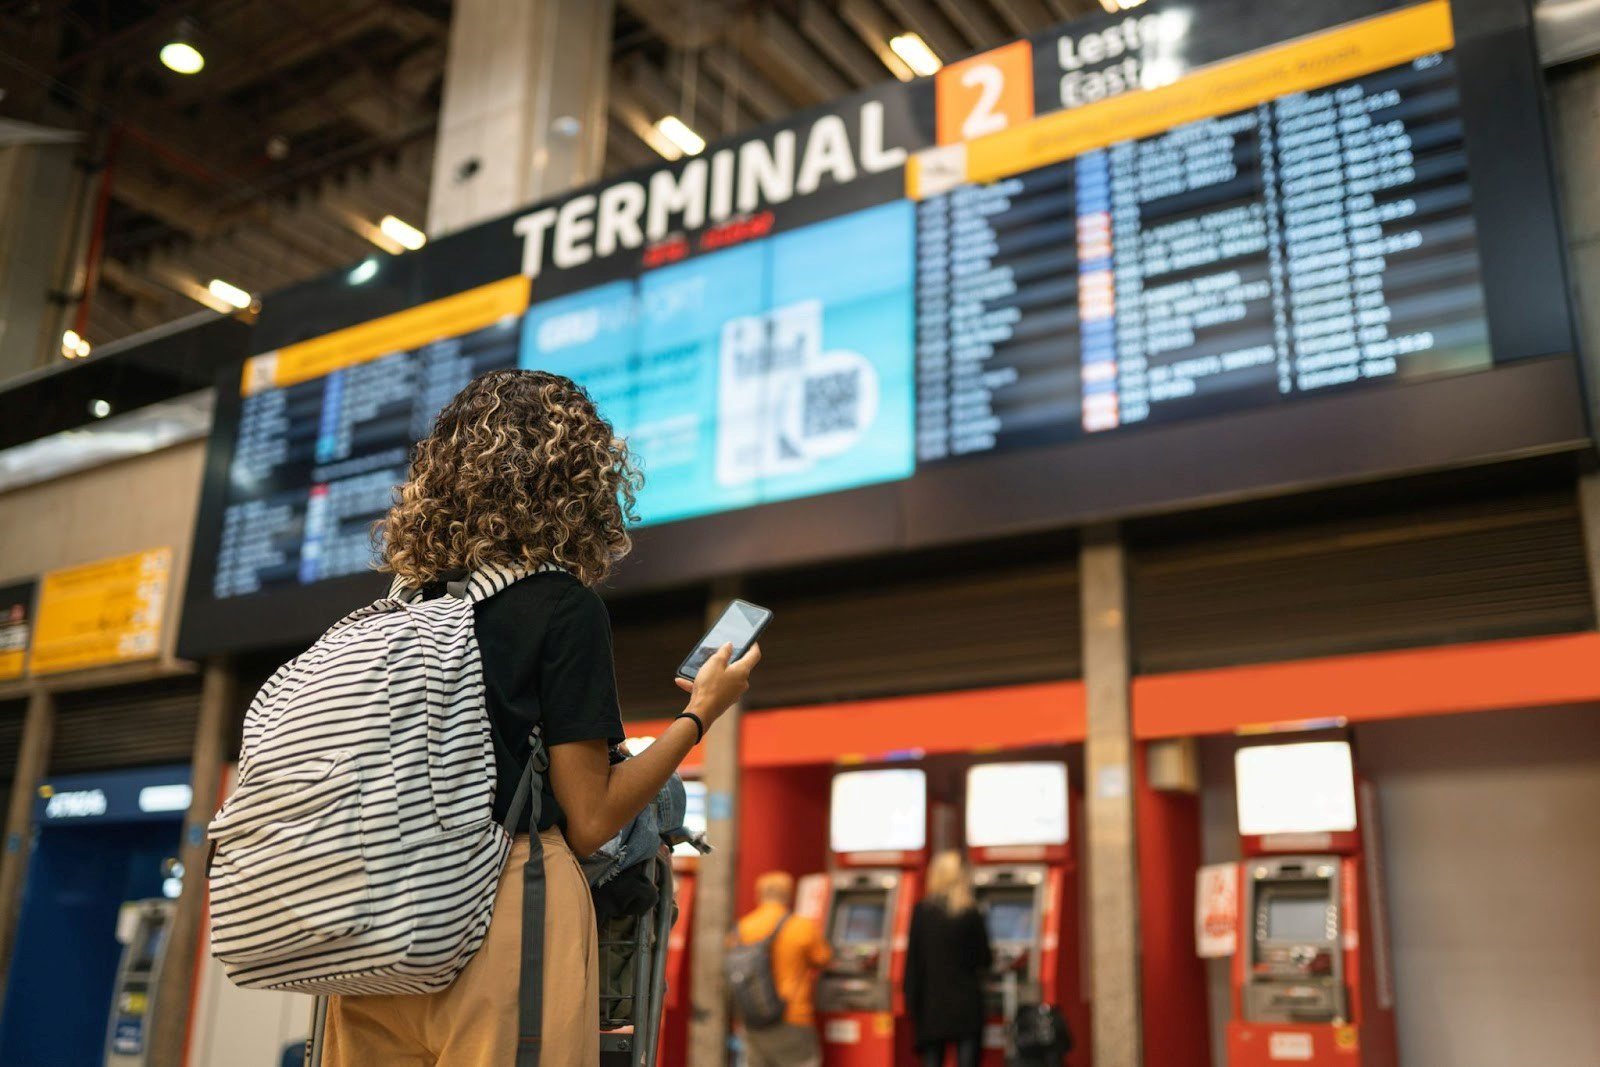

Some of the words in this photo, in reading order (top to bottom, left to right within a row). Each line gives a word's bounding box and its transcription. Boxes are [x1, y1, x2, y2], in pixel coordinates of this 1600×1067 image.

[1060, 57, 1138, 108] East
[513, 101, 907, 278] TERMINAL
[961, 63, 1007, 137] 2
